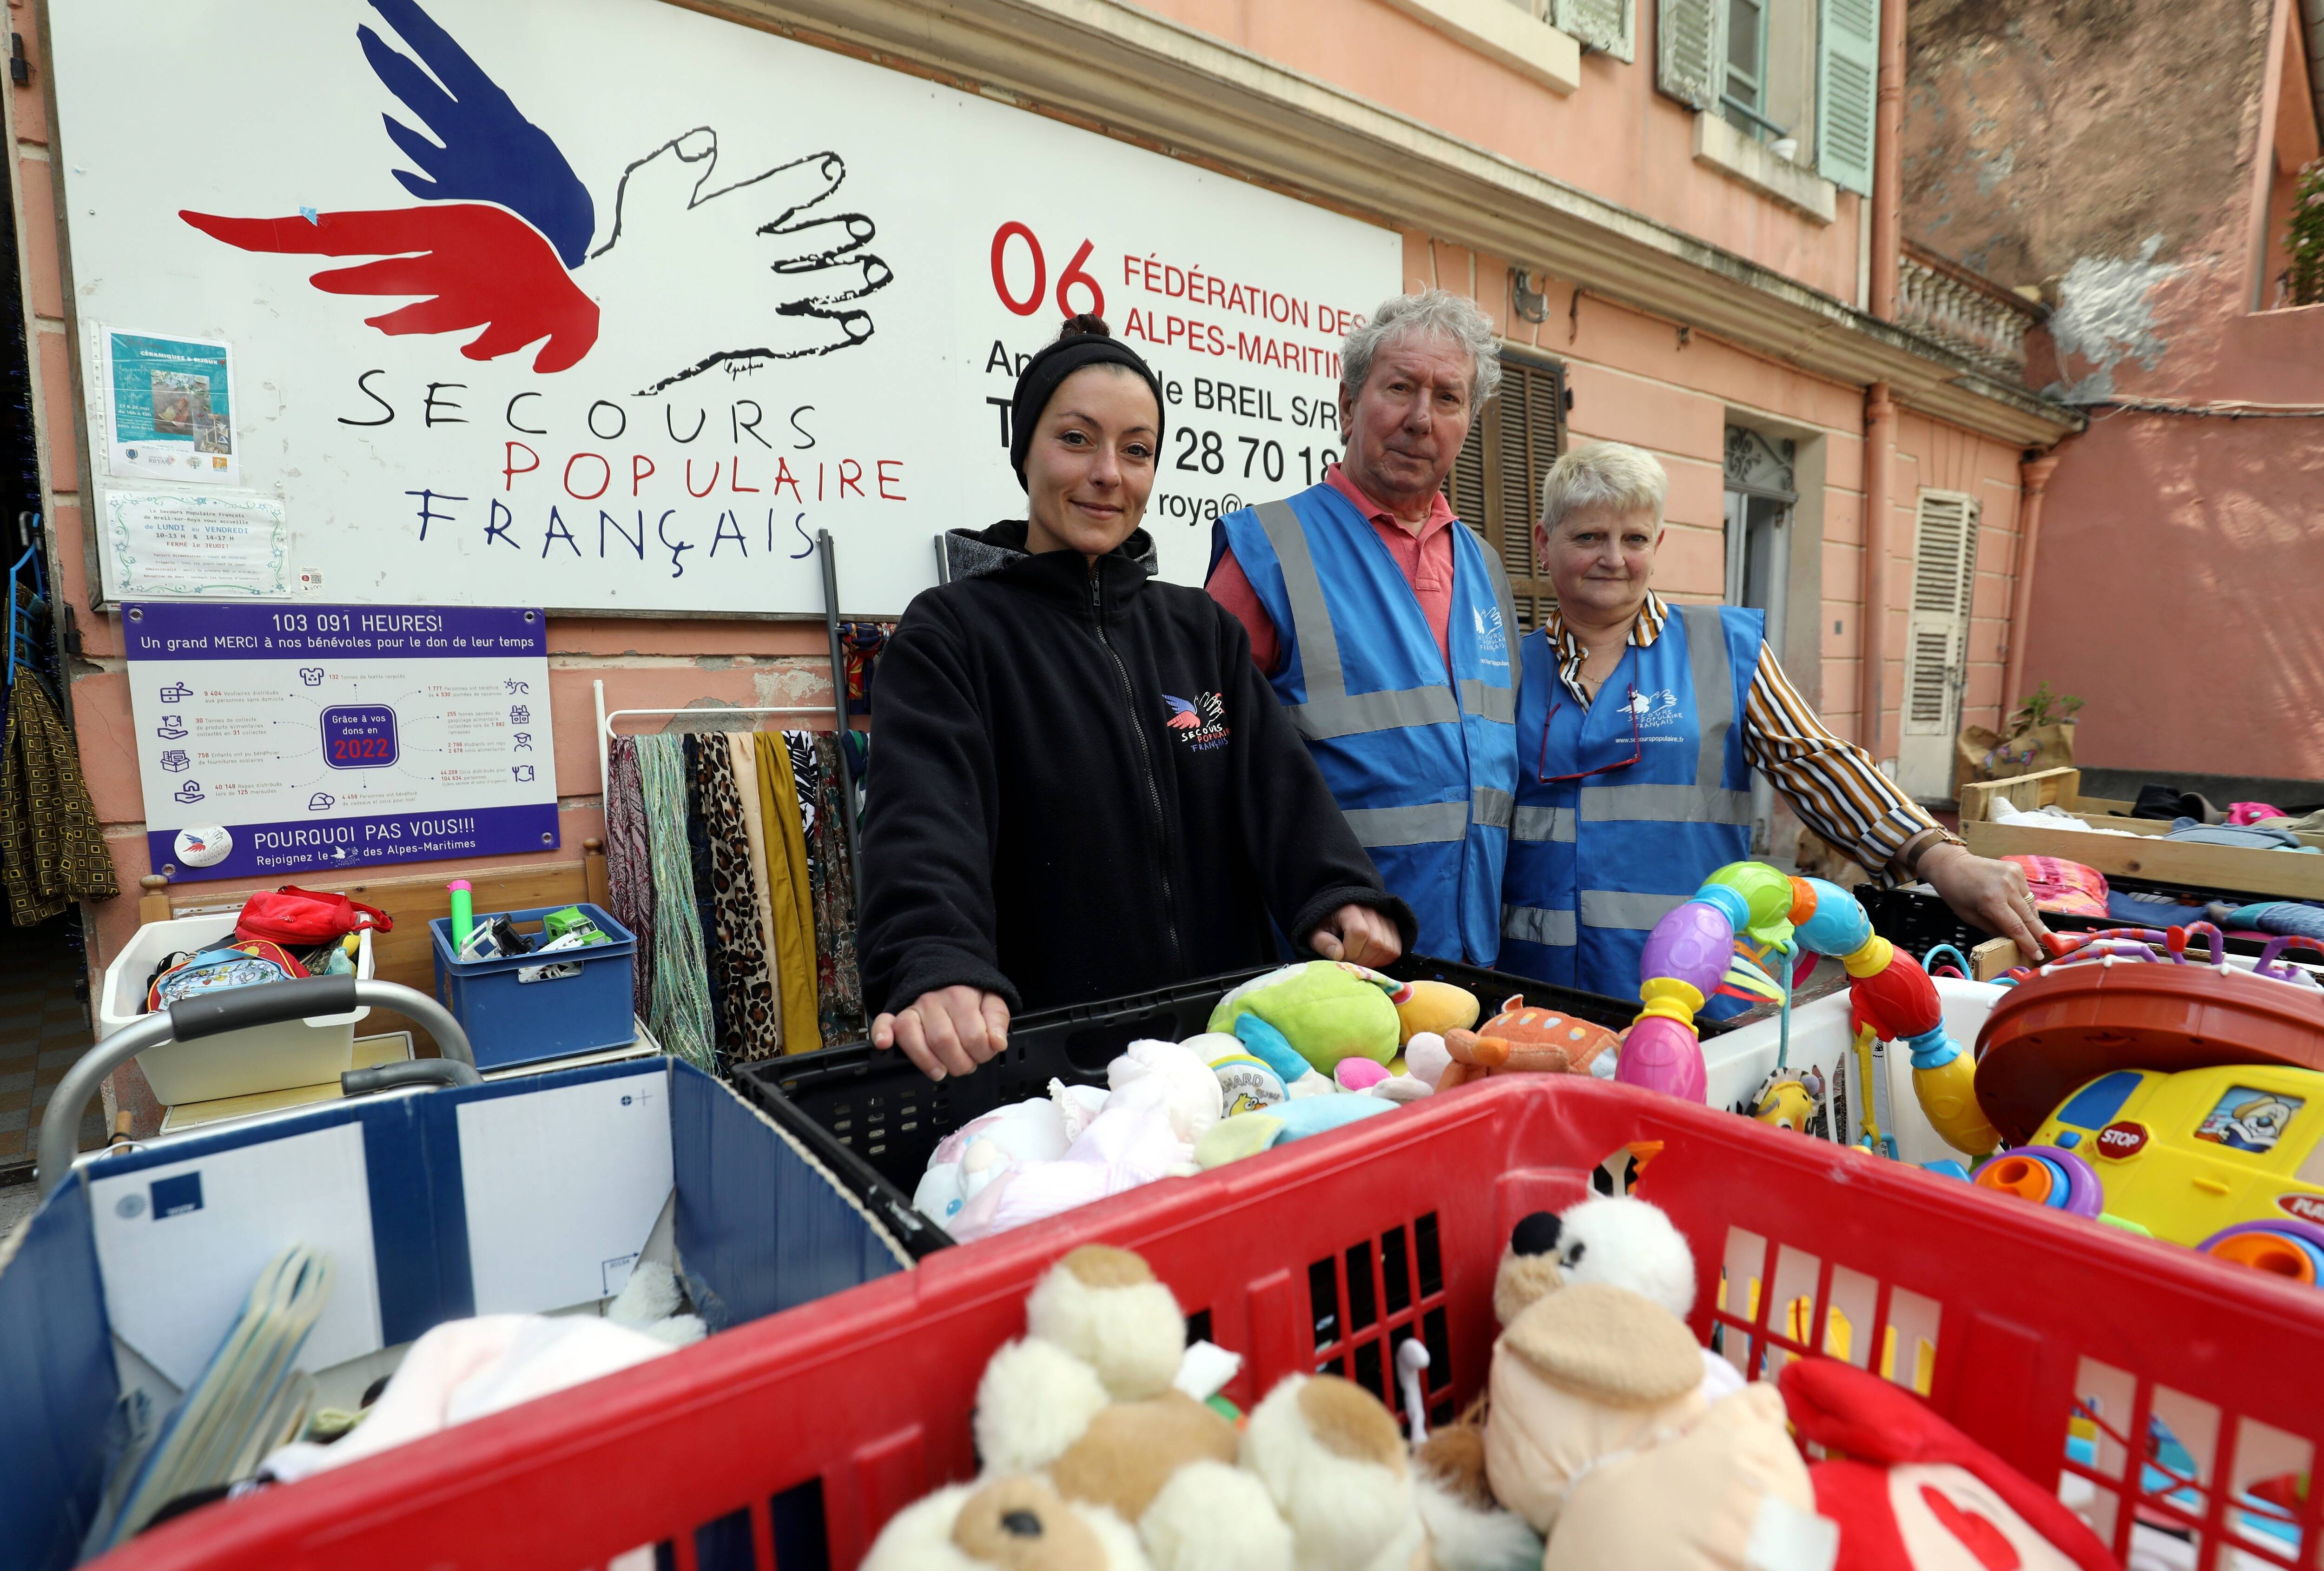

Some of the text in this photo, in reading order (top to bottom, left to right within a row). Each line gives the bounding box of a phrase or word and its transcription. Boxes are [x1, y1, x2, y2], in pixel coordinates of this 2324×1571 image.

[991, 220, 1104, 319] 06
[1124, 252, 1308, 328] FÉDÉRATION
[140, 350, 185, 361] CÉRAMIQUES
[1195, 377, 1282, 422] BREIL
[337, 370, 816, 449] SECOURS
[1176, 426, 1224, 474] 28
[1238, 435, 1284, 482] 70
[502, 441, 908, 504] POPULAIRE
[405, 489, 814, 578] FRANÇAIS
[273, 614, 443, 632] 103 091 HEURES!
[141, 636, 534, 651] Un grand MERCI à nos bénévoles pour le don de leur temps
[1480, 643, 1505, 652] FRANÇAIS
[332, 715, 358, 724] Grâce
[1628, 709, 1672, 721] SECOURS
[1641, 713, 1684, 723] POPULAIRE
[342, 727, 364, 736] dons
[1182, 723, 1222, 742] SECOURS
[334, 738, 389, 759] 2022
[1190, 737, 1228, 752] FRANÇAIS
[255, 817, 475, 850] POURQUOI PAS VOUS!!!
[256, 839, 476, 866] Rejoignez le des Alpes-Maritimes
[2101, 1129, 2140, 1147] STOP
